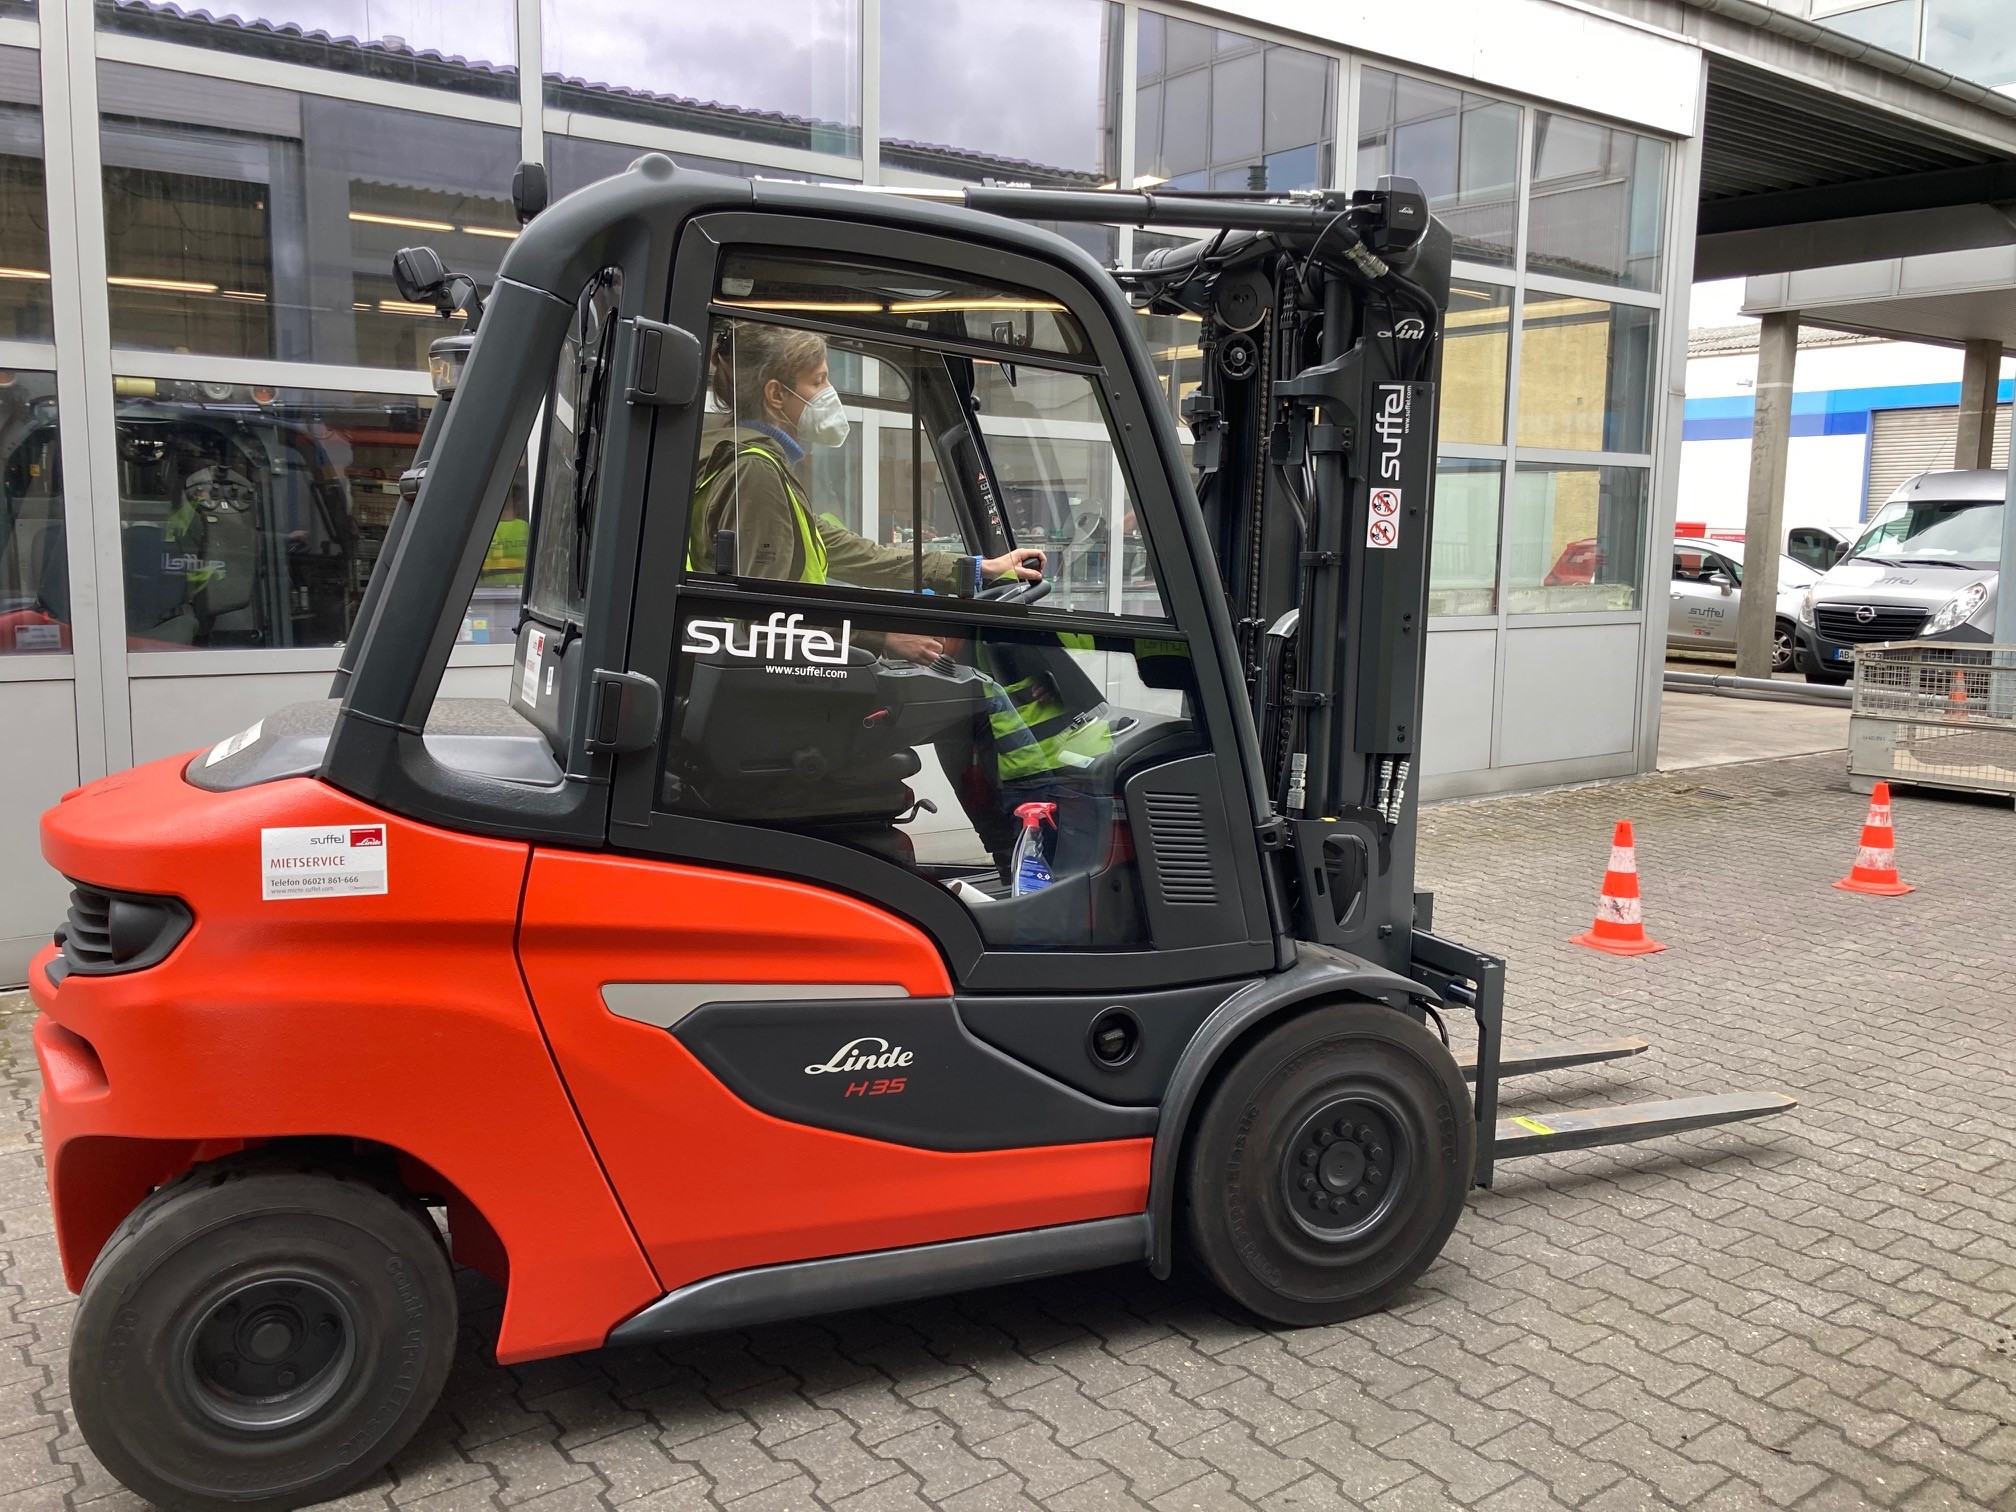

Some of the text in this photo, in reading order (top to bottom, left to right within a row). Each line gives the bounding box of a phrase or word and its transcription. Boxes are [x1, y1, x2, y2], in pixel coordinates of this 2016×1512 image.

[1404, 385, 1412, 434] www.suffel.com
[1375, 384, 1405, 481] suffel
[1688, 607, 1725, 618] suffel
[682, 612, 851, 664] suffel
[1838, 650, 1850, 660] AB
[765, 665, 848, 679] www.suffel.com
[310, 834, 382, 846] suffel Linde
[270, 855, 346, 869] MIETSERVICE
[271, 875, 359, 887] Telefon 06021 861-666
[804, 1037, 914, 1075] Linde
[844, 1077, 908, 1098] H 35
